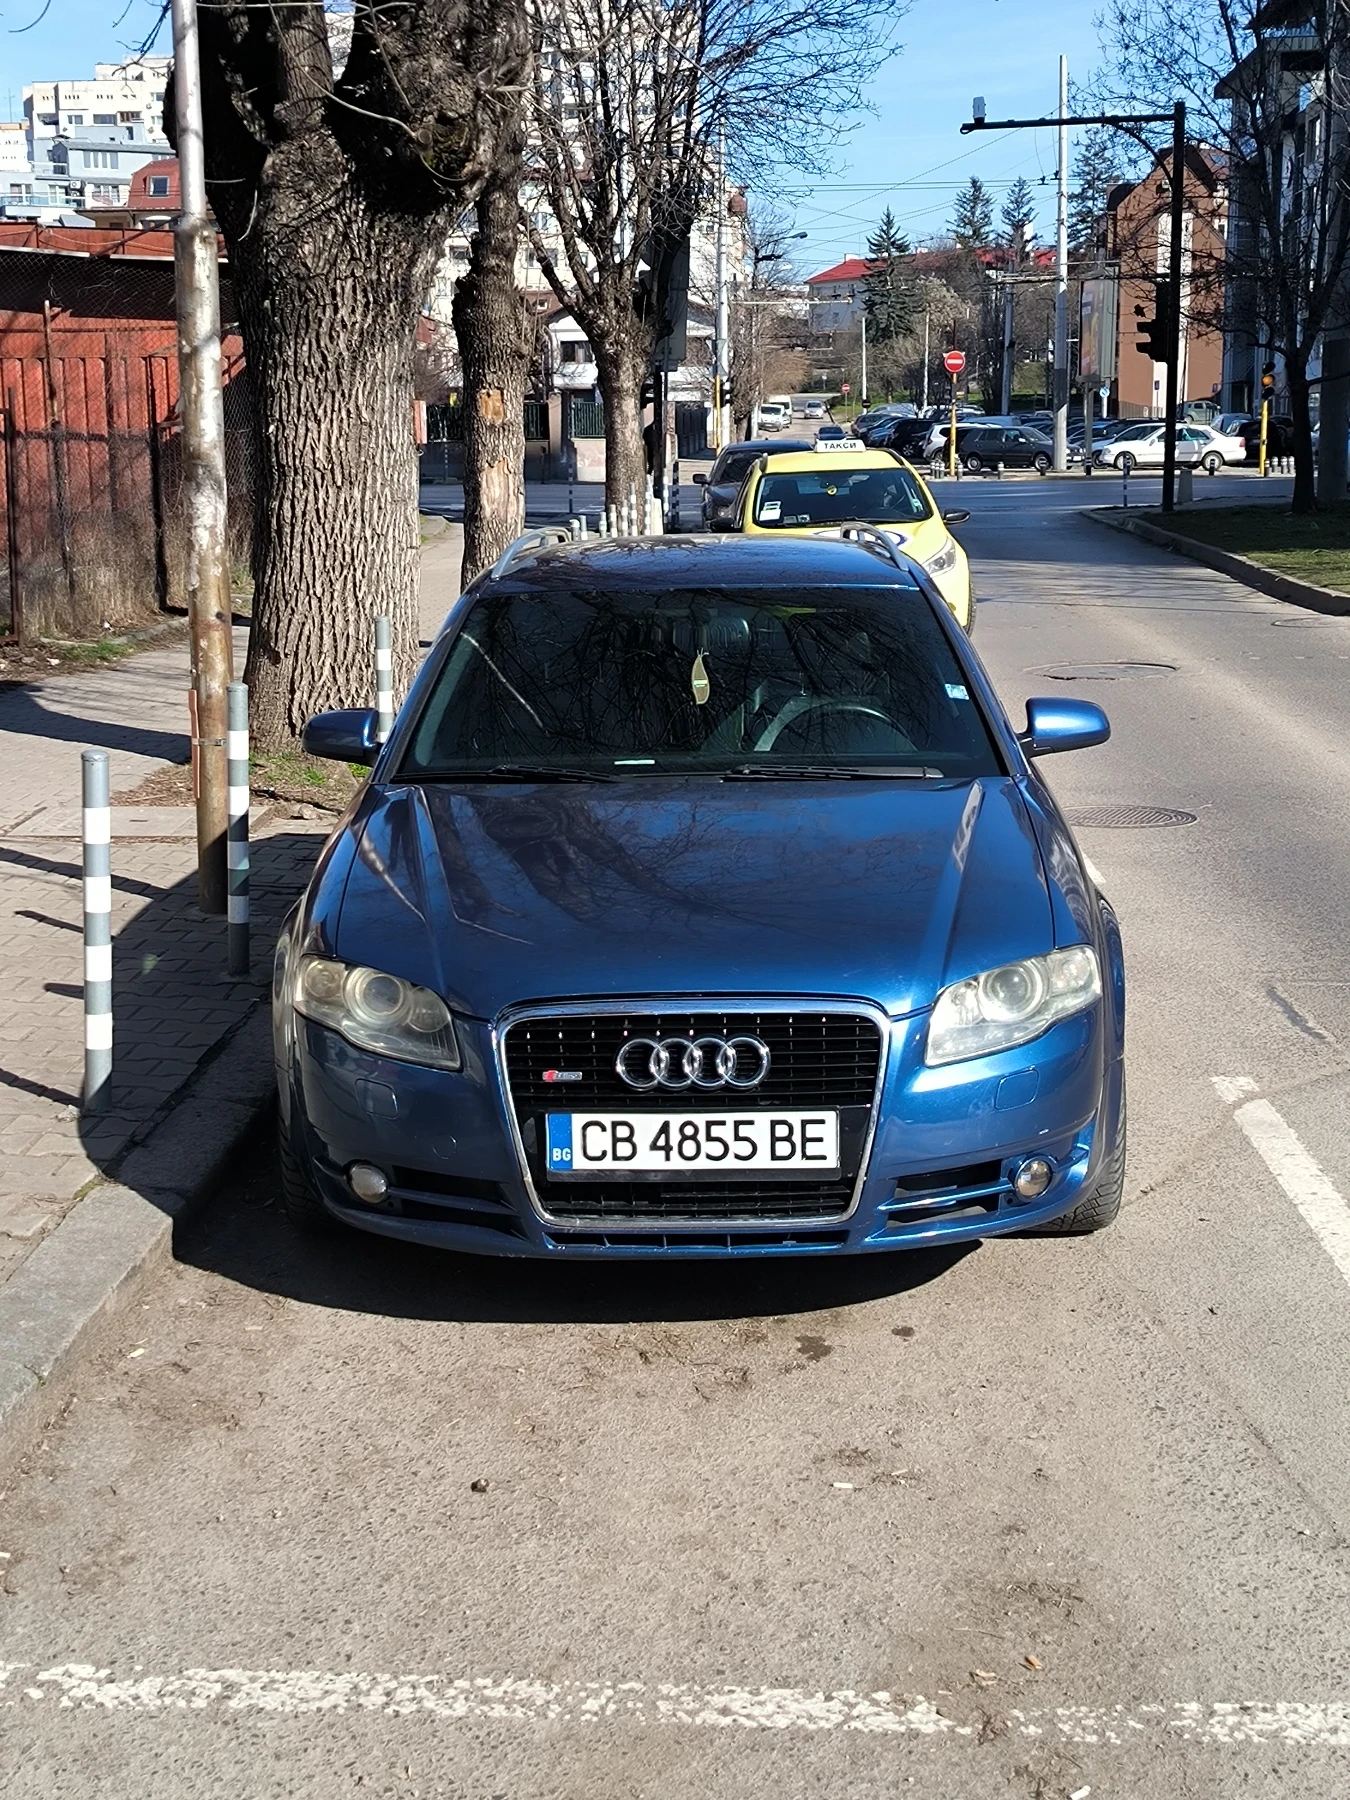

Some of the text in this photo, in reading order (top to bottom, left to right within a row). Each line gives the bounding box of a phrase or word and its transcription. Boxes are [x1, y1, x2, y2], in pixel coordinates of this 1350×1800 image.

[552, 1147, 571, 1161] BG
[581, 1119, 828, 1161] CB 4855 BE
